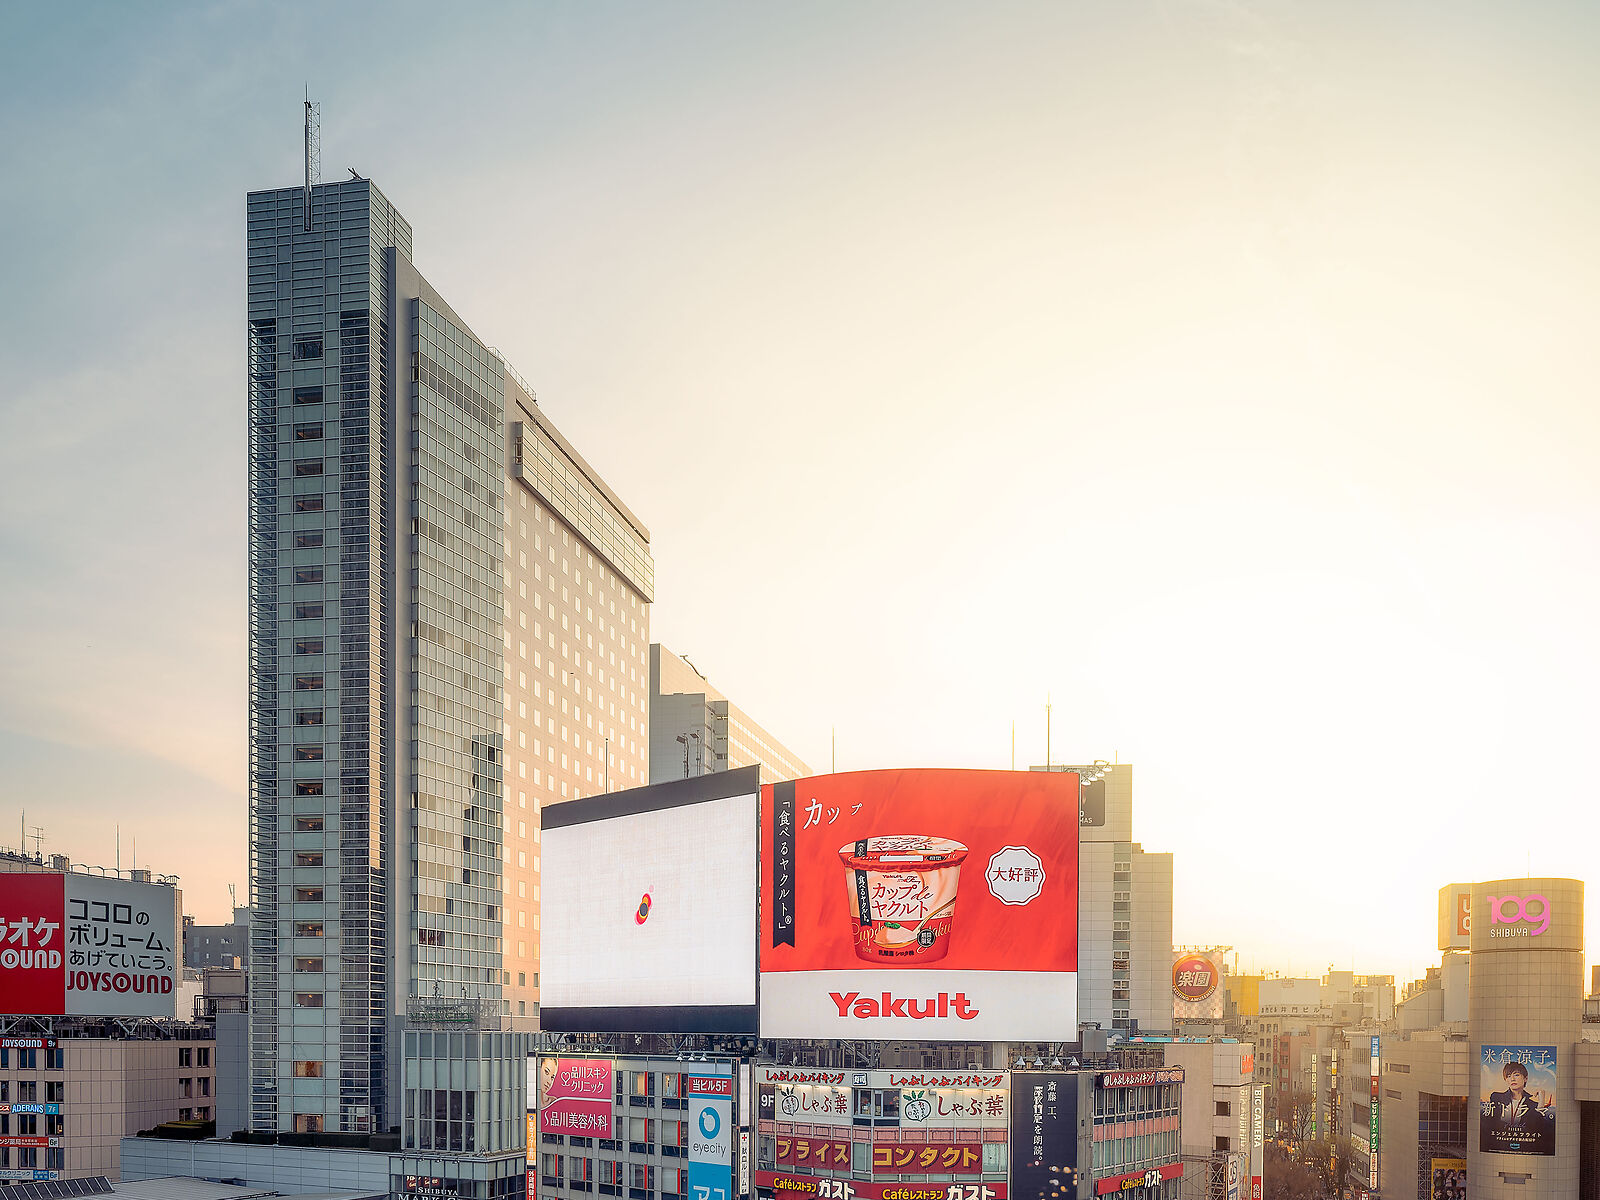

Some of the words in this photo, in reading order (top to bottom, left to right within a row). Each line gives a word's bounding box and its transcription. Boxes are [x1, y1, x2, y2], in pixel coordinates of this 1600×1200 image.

[992, 866, 1039, 884] 大好評
[872, 883, 918, 900] カップ
[69, 898, 150, 926] ココロの
[872, 900, 928, 918] ヤクルト
[1487, 894, 1551, 936] 109
[69, 923, 172, 952] ボリューム、
[1490, 928, 1528, 937] SHIBUYA
[69, 949, 173, 972] あげていこう。
[67, 970, 173, 994] JOYSOUND
[830, 992, 980, 1021] Yakult
[2, 1039, 42, 1048] JOYSOUND
[1483, 1048, 1555, 1065] 米倉涼子、
[570, 1065, 609, 1080] 品川スキン
[765, 1069, 845, 1085] しゃぶしゃぶバイキング
[889, 1073, 1004, 1088] しゃぶしゃぶバイキング
[570, 1080, 604, 1094] クリニック
[692, 1077, 728, 1092] 当ビル5F
[761, 1094, 775, 1107] 9F
[802, 1092, 848, 1115] しゃぶ葉
[937, 1095, 1004, 1117] しゃぶ葉
[1254, 1089, 1262, 1106] BIC
[12, 1104, 44, 1114] ADERANS
[1482, 1101, 1554, 1120] 新ドラマ。
[550, 1110, 609, 1132] 品川美容外科
[1253, 1108, 1262, 1148] CAMERA
[692, 1142, 727, 1158] eyecity
[777, 1139, 849, 1164] プライス
[873, 1147, 980, 1168] コンタクト
[1144, 1169, 1162, 1188] ガスト
[417, 1186, 458, 1196] SHIBUYA
[819, 1179, 855, 1200] ガスト
